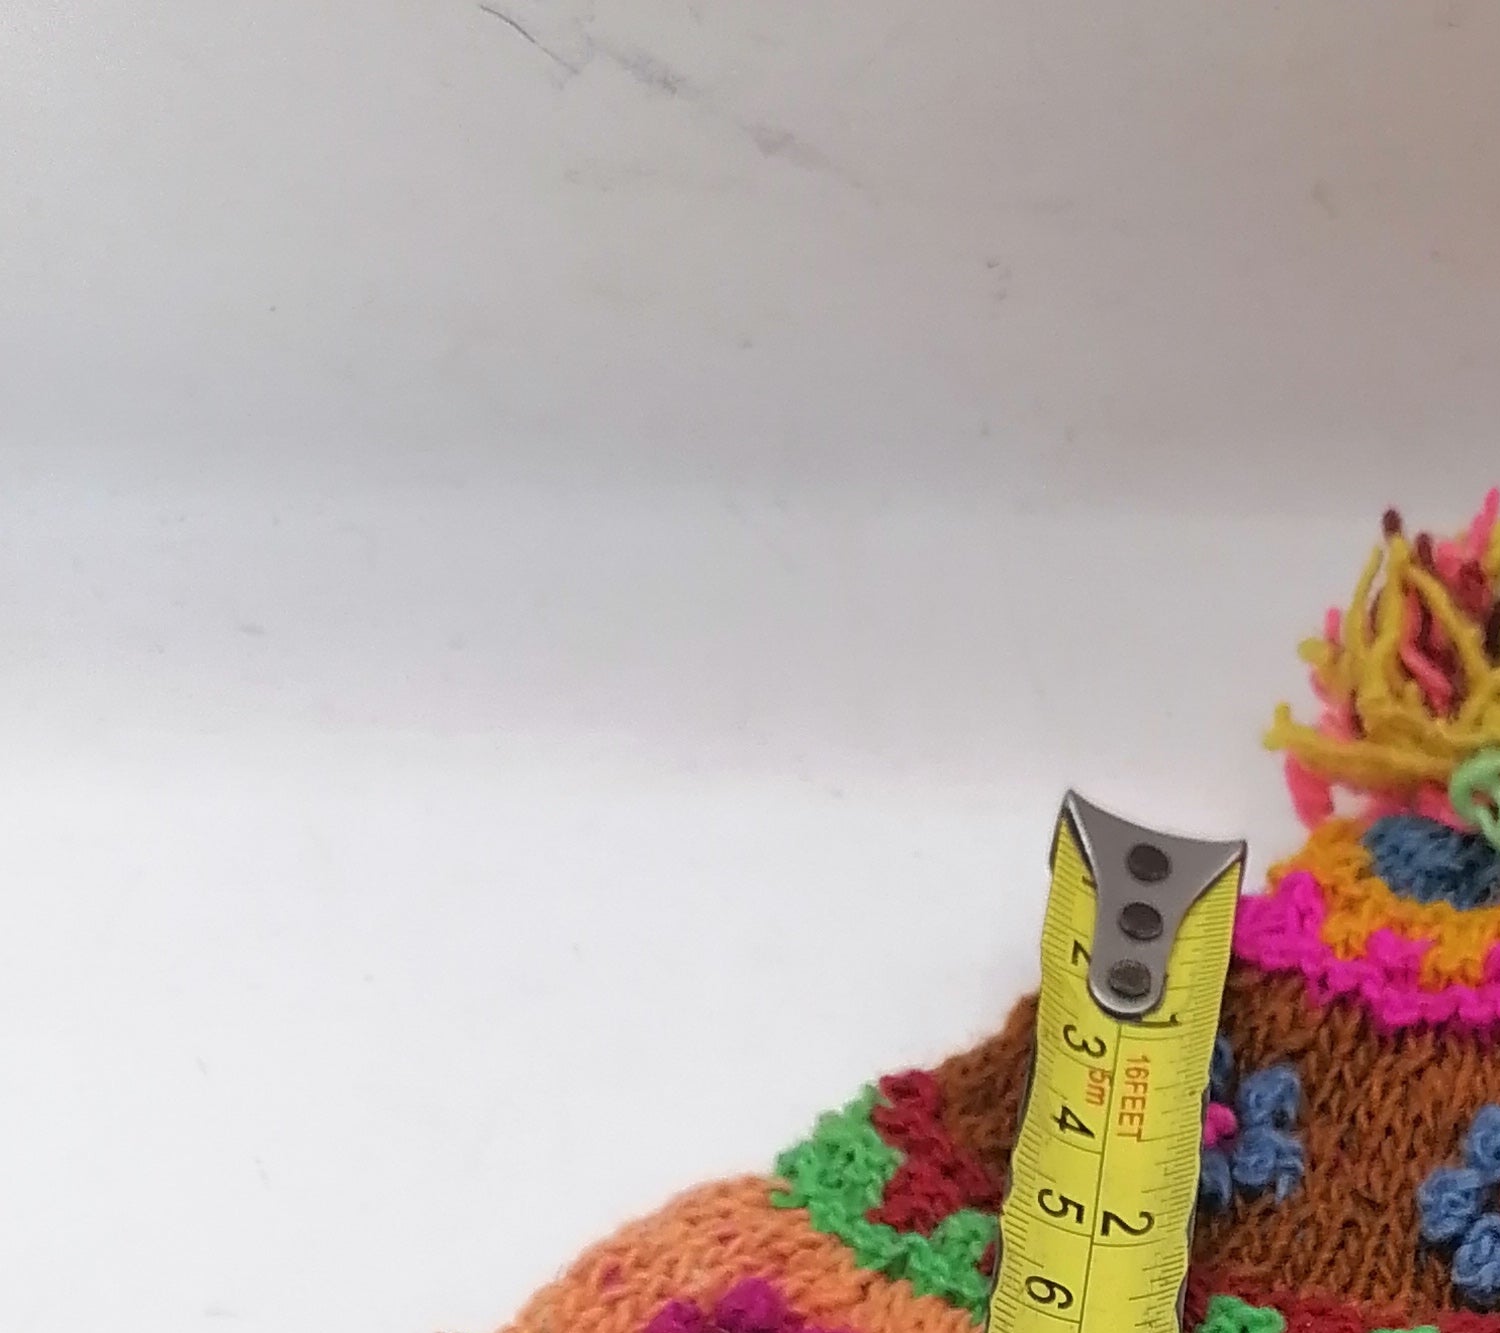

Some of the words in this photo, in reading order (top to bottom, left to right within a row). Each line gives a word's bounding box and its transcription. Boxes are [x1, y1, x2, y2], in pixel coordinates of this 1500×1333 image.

[1063, 1023, 1107, 1059] 3
[1116, 1054, 1151, 1143] 16FEET
[1052, 1104, 1095, 1139] 4
[1037, 1187, 1084, 1225] 5
[1100, 1209, 1154, 1237] 2
[1024, 1275, 1073, 1310] 6
